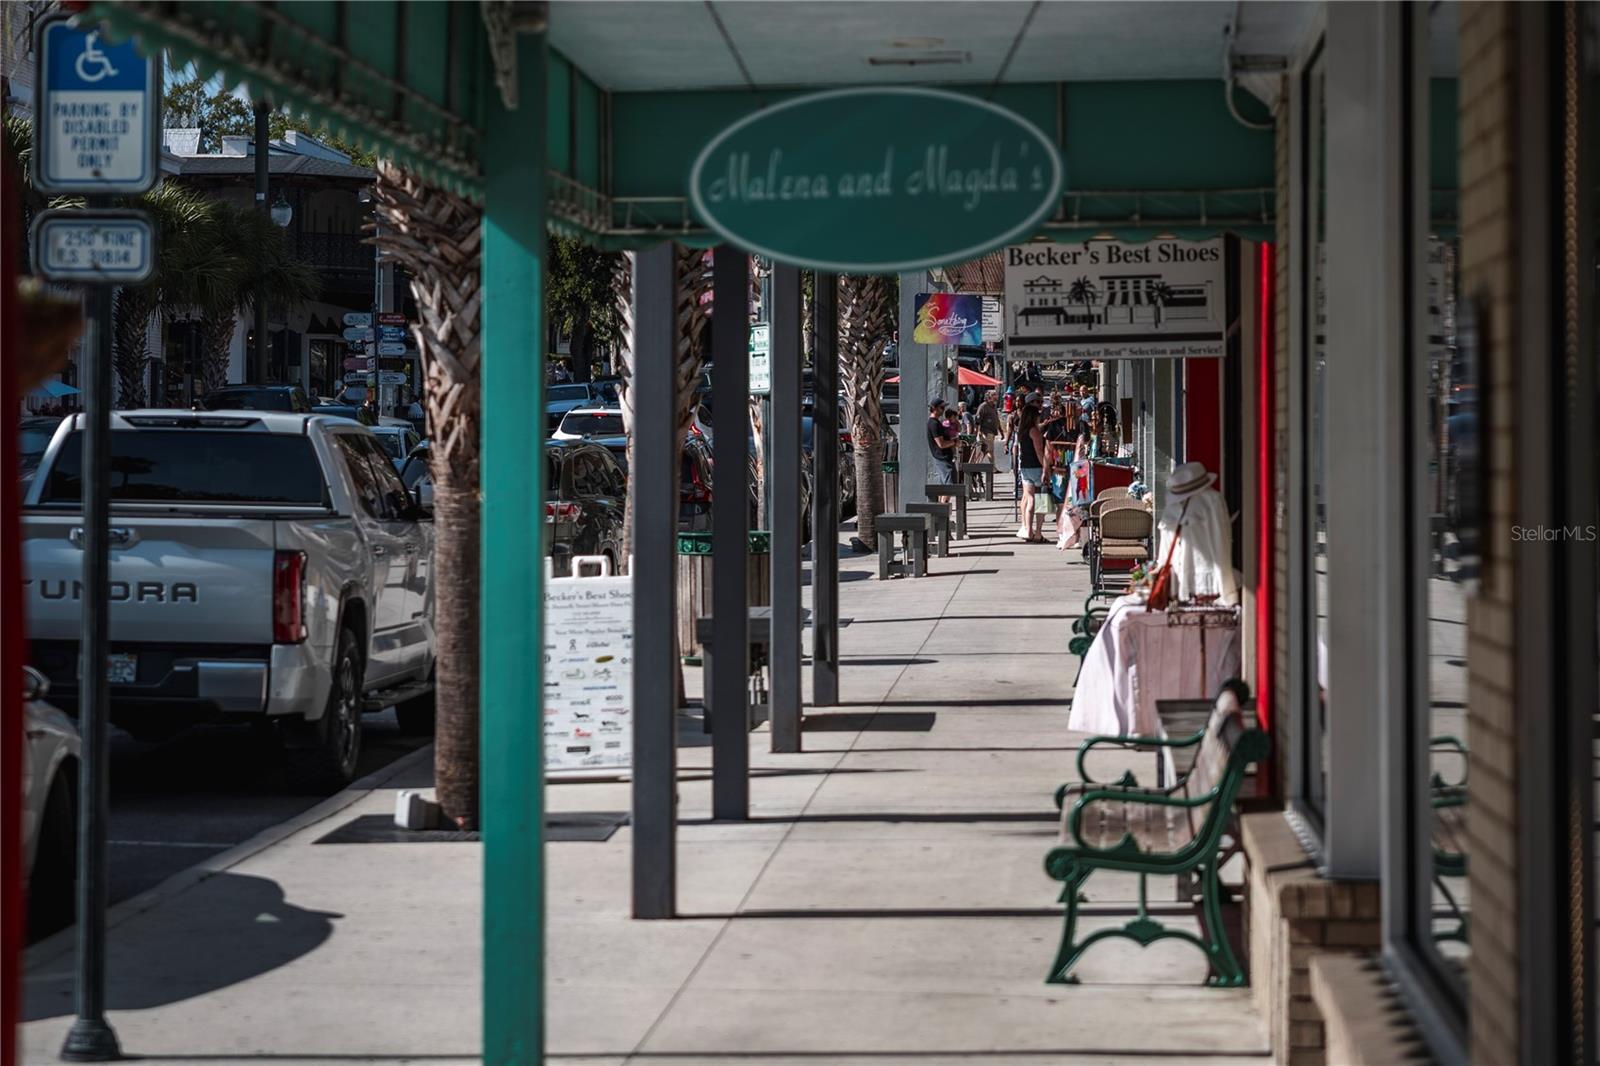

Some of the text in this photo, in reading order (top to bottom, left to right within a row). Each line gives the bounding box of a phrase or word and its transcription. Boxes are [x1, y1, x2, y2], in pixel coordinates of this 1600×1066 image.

[54, 102, 138, 117] PARKING BY
[63, 119, 129, 134] DISABLED
[71, 136, 119, 151] PERMIT
[77, 153, 113, 168] ONLY
[838, 146, 895, 197] and
[905, 143, 1044, 211] Magda's
[1008, 242, 1220, 267] Becker's Best Shoes
[1011, 349, 1047, 360] Offering
[1049, 350, 1064, 358] our
[1129, 346, 1167, 356] Selection
[1170, 346, 1186, 355] and
[585, 590, 606, 600] Best
